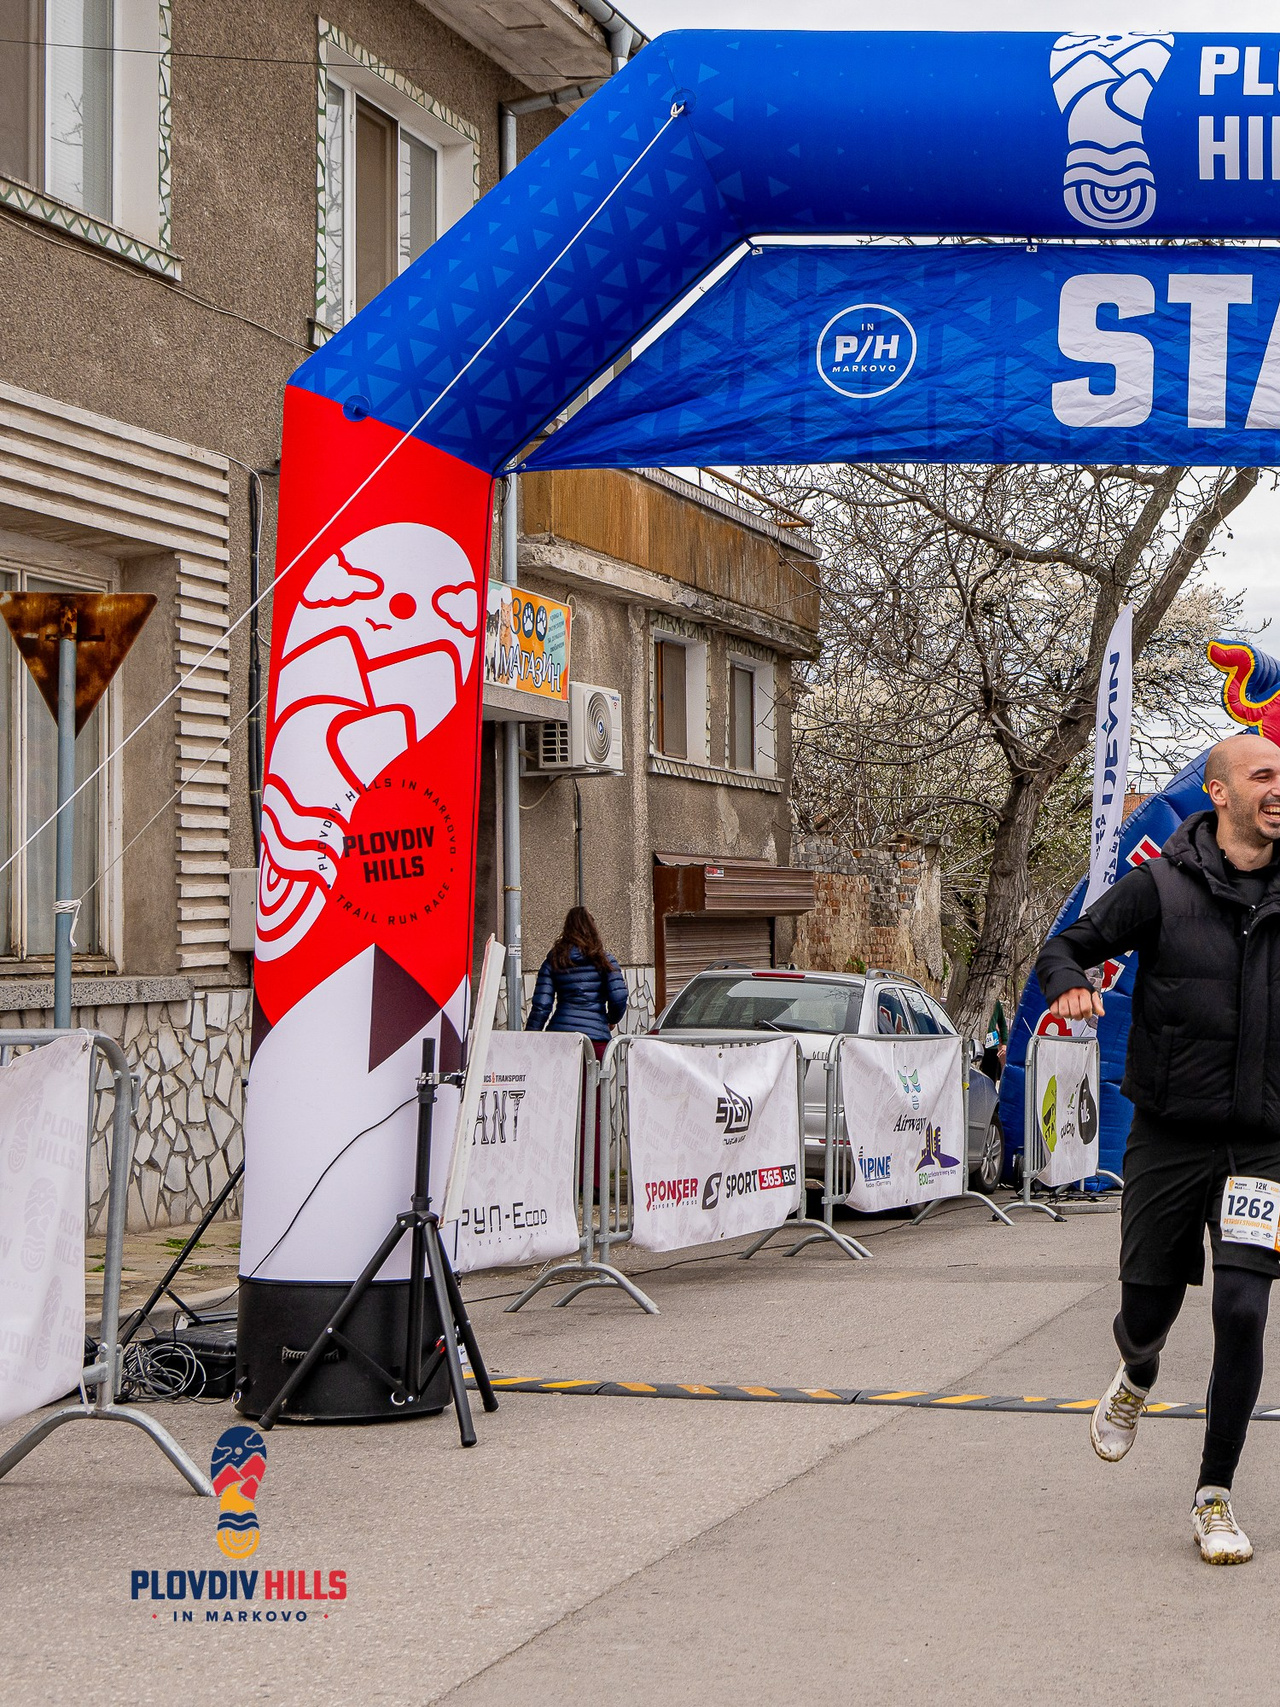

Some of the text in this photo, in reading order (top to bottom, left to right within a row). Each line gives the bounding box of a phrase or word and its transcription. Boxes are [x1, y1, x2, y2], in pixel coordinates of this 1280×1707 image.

[861, 323, 875, 331] IN
[834, 334, 900, 363] P/H
[831, 364, 897, 373] MARKOVO
[500, 643, 562, 693] МАГАЗИН
[1101, 651, 1120, 806] DEVIN
[315, 777, 457, 872] PLOVDIV HILLS IN MARKOVO
[342, 826, 435, 858] PLOVDIV
[363, 855, 425, 884] HILLS
[336, 881, 450, 925] TRAIL RUN RACE
[495, 1074, 526, 1083] TRANSPORT
[645, 1177, 699, 1213] SPONSER
[725, 1168, 796, 1199] SPORT 365.BG
[1228, 1195, 1274, 1222] 1262
